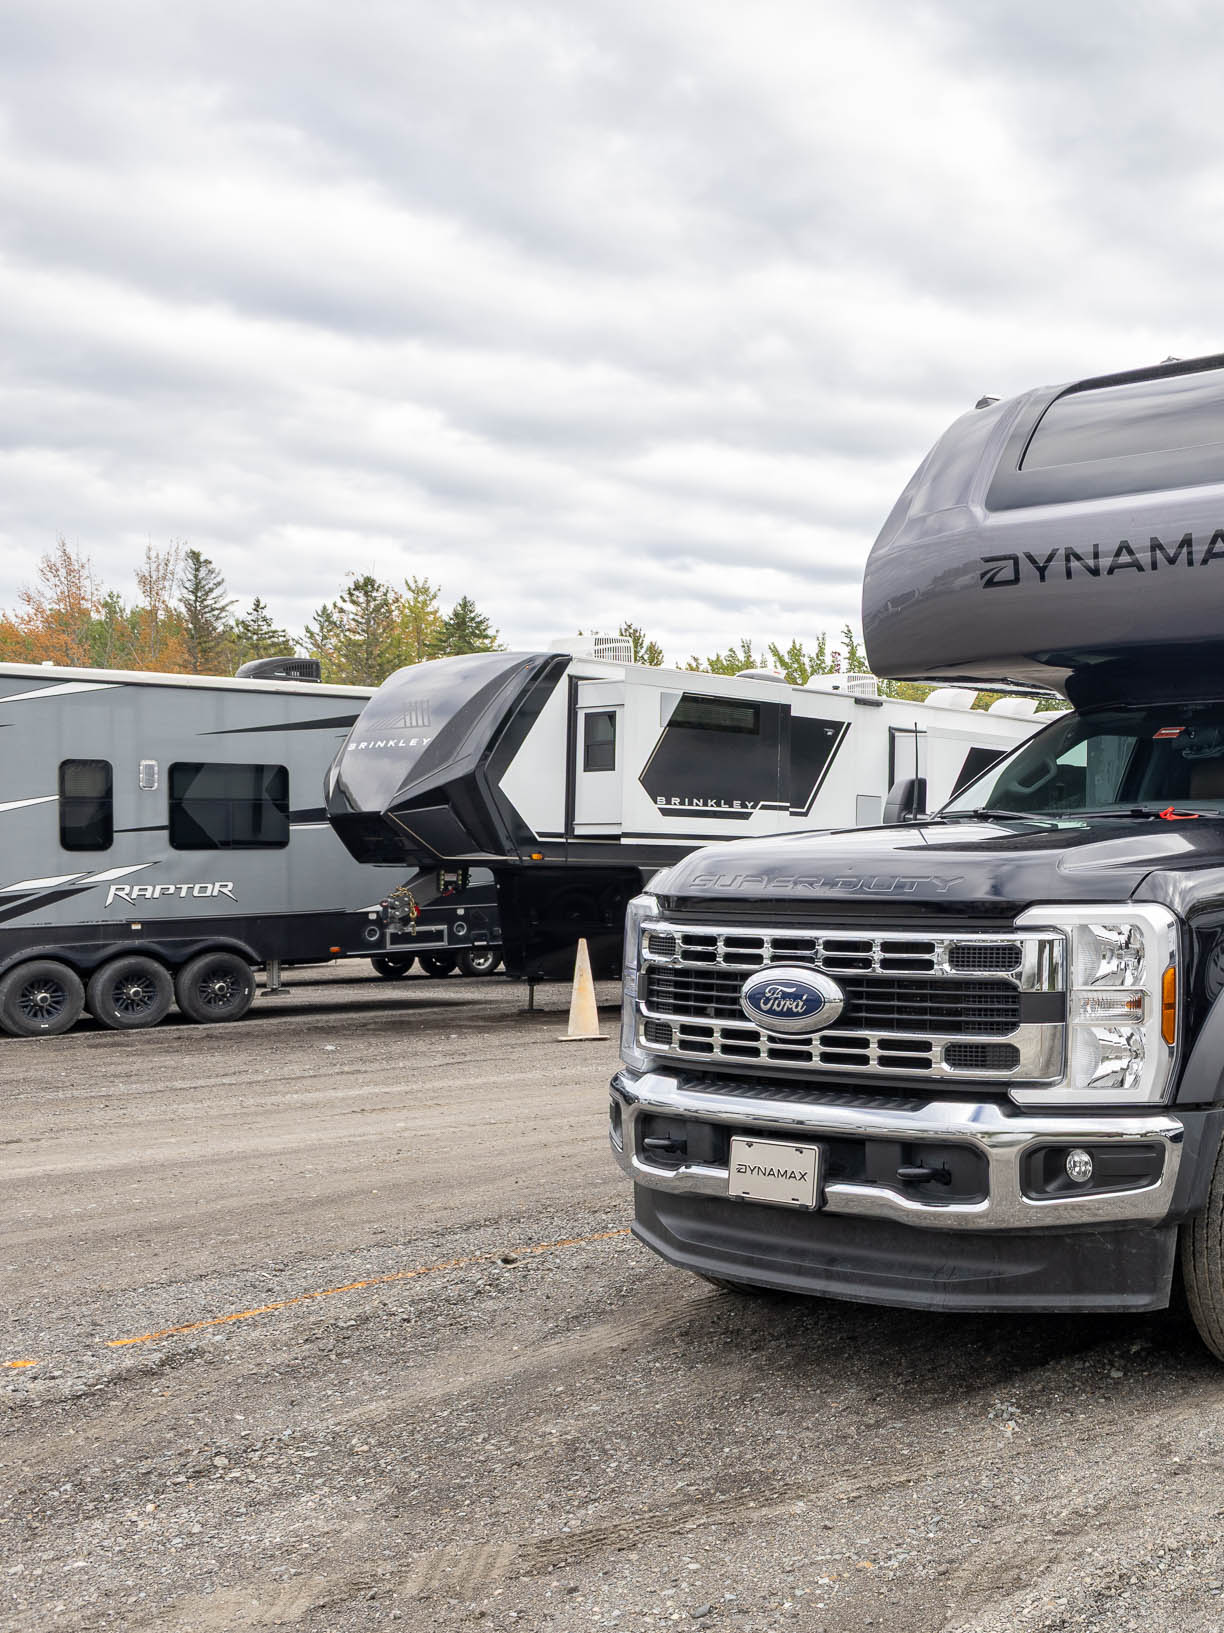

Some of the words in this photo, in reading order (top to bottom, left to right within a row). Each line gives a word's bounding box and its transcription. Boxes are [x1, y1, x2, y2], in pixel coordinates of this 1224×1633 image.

[347, 738, 431, 751] BRINKLEY
[656, 796, 755, 809] BRINKLEY
[688, 873, 825, 891] SUPER
[828, 875, 966, 893] DUTY
[104, 881, 239, 909] RAPTOR
[760, 984, 808, 1014] Ford
[735, 1163, 808, 1183] DYNAMAX
